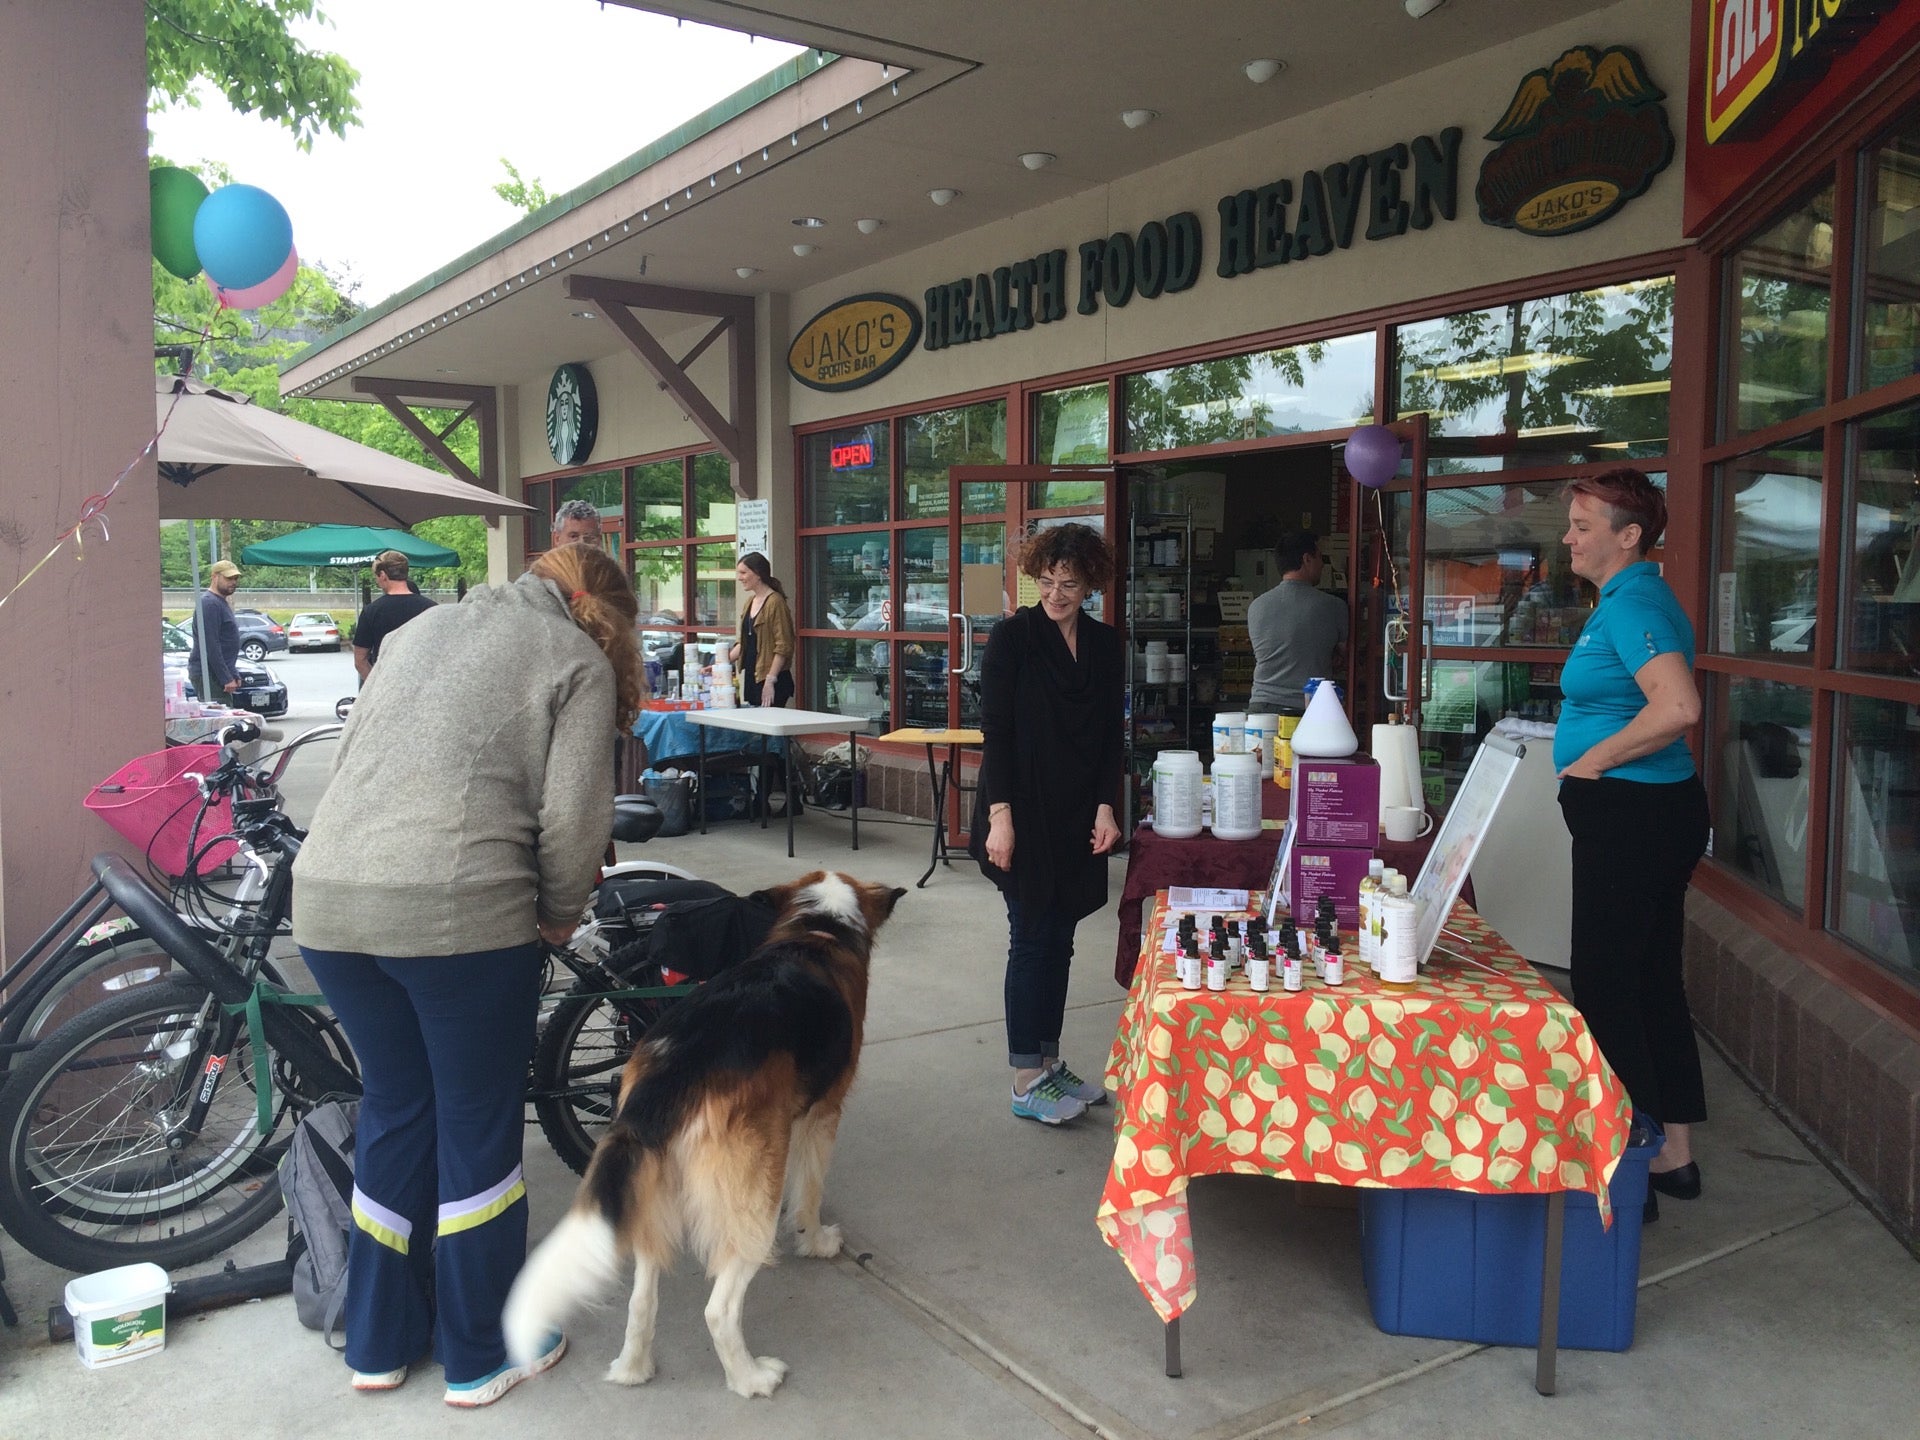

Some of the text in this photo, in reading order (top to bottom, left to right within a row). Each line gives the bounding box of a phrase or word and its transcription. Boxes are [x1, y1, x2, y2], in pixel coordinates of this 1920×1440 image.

[1530, 186, 1604, 219] JAKO'S
[1537, 209, 1589, 229] SPORTS BAR
[923, 126, 1463, 351] HEALTH FOOD HEAVEN
[804, 313, 895, 369] JAKO'S
[818, 354, 876, 380] SPORTS BAR
[831, 443, 871, 468] OPEN
[330, 555, 376, 565] STARBUCK
